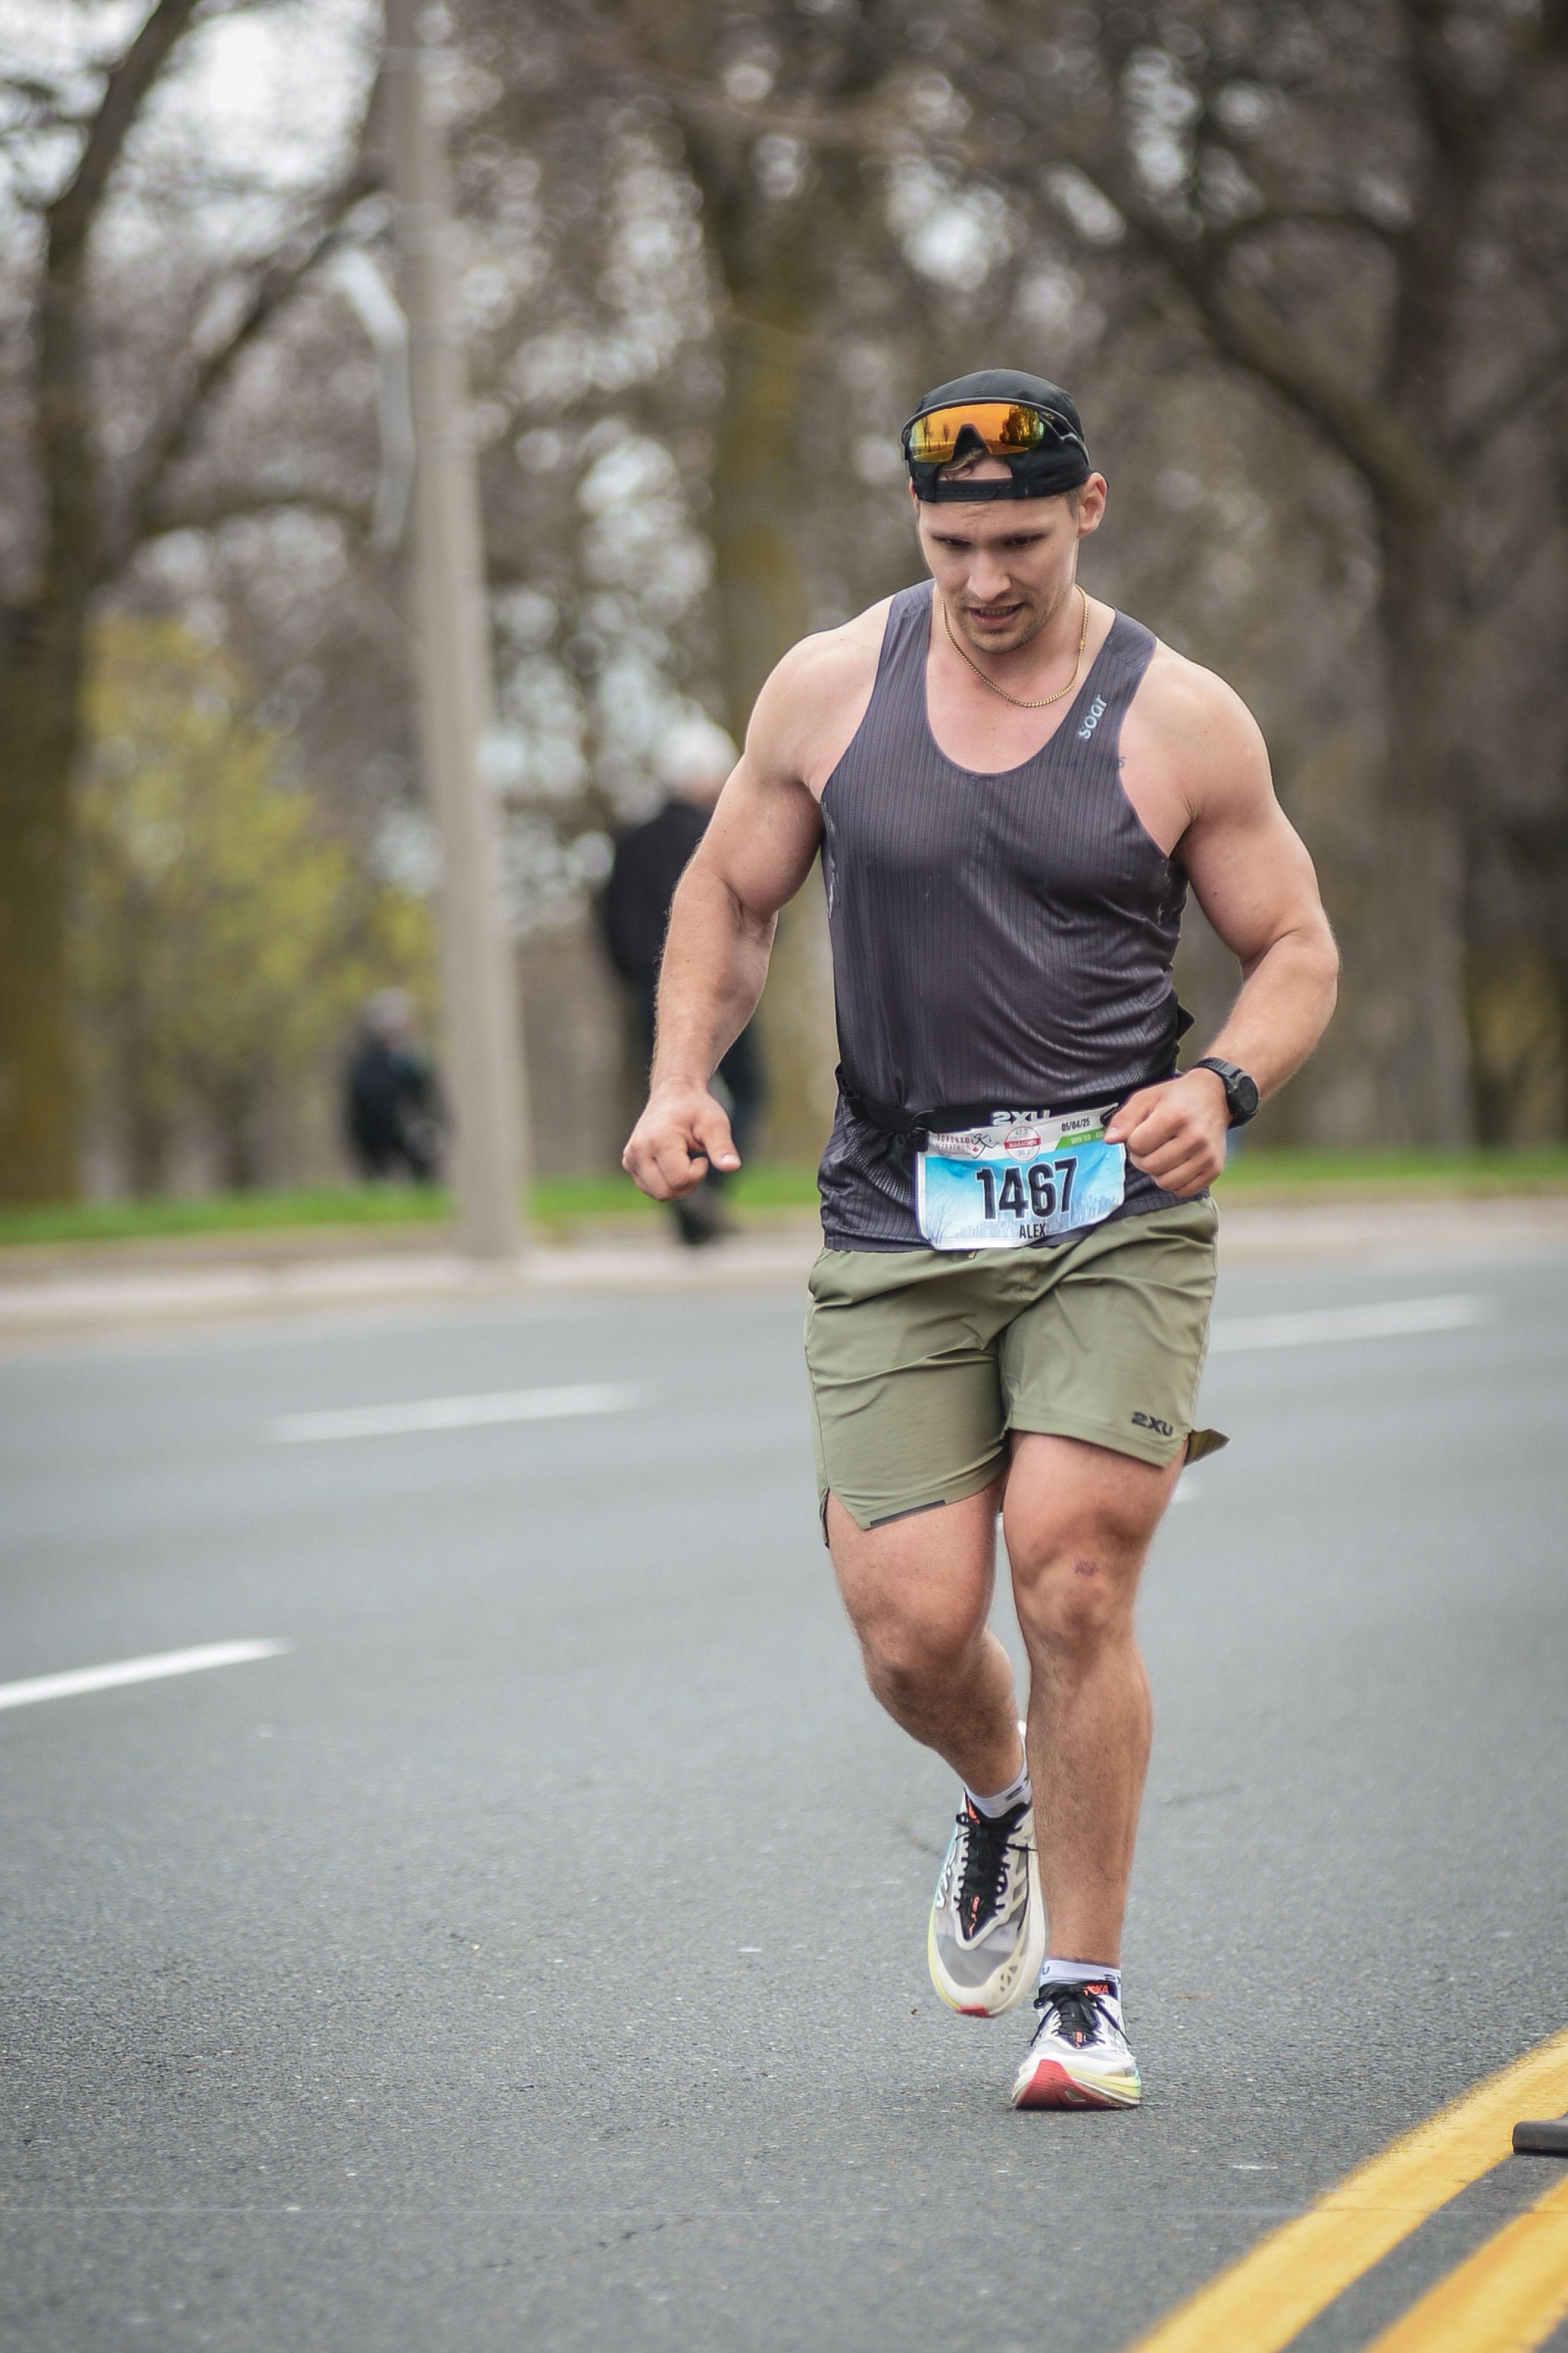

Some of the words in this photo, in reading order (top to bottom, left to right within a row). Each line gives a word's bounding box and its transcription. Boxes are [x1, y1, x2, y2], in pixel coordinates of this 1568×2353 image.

[1077, 694, 1106, 739] soar
[993, 1109, 1050, 1126] 2XU
[1061, 1118, 1090, 1132] 05/04/25
[976, 1158, 1077, 1219] 1467
[1019, 1222, 1046, 1239] ALEX
[1132, 1412, 1173, 1437] 2XU
